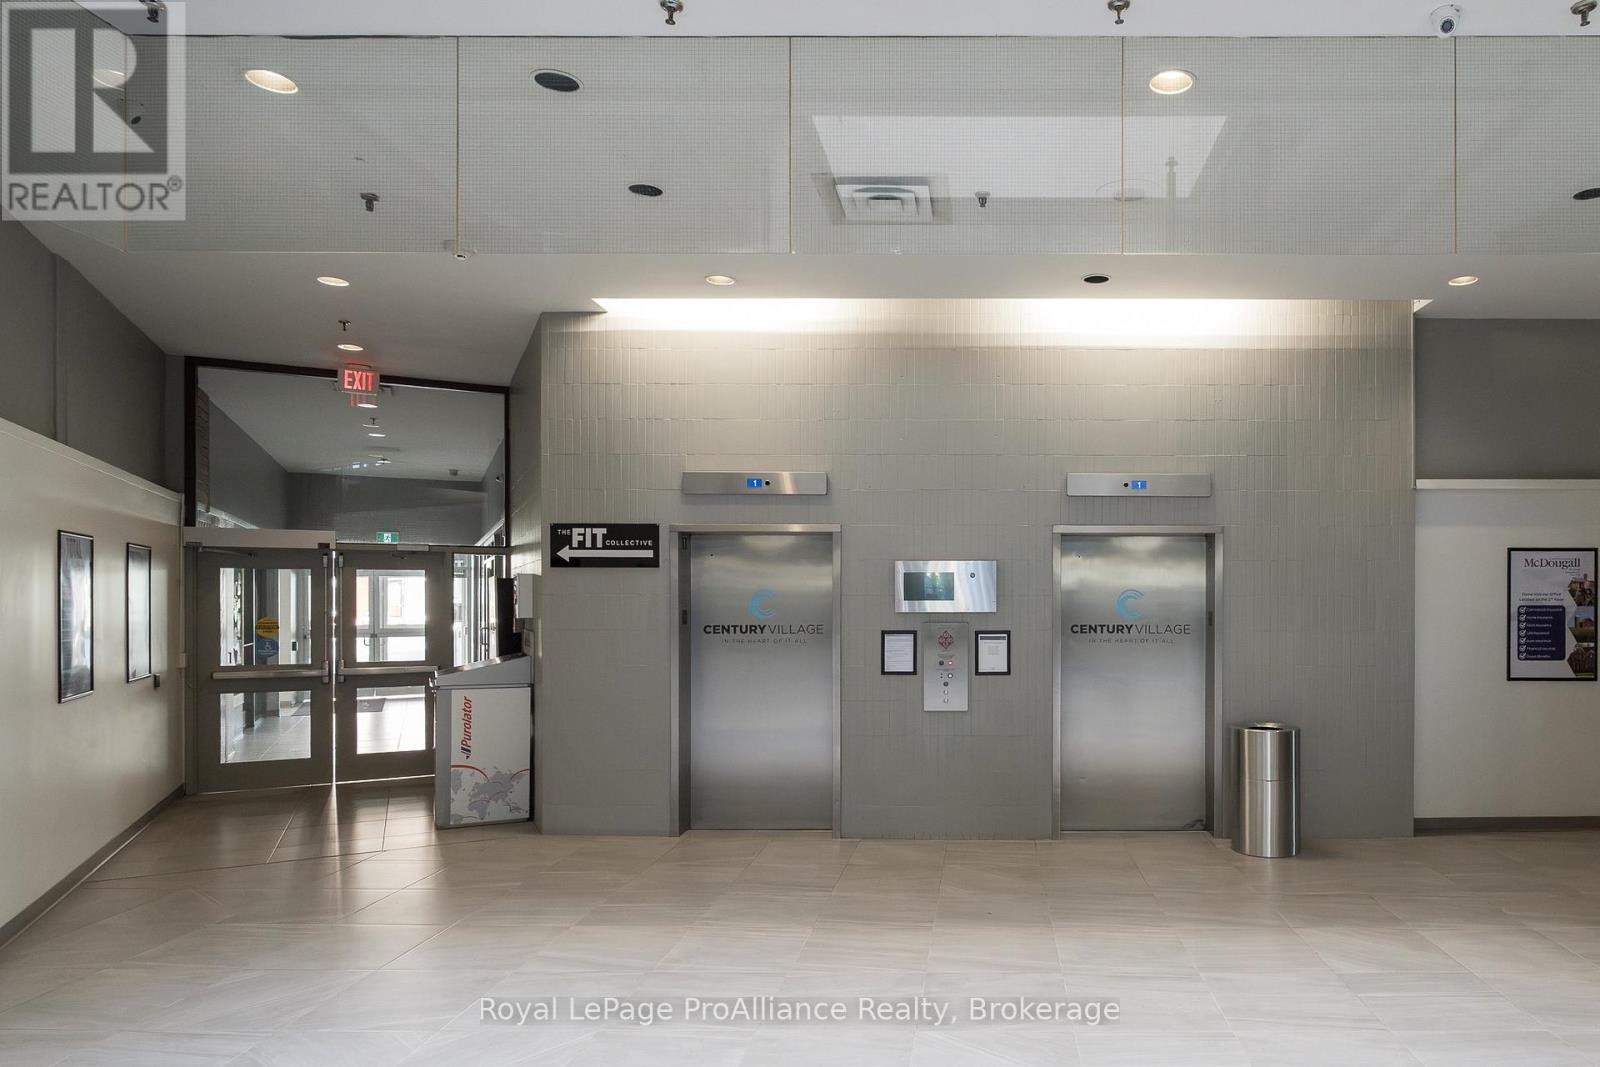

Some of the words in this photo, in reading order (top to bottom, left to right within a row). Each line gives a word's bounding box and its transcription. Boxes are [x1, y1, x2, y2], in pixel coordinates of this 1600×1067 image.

[344, 369, 374, 391] EXIT
[753, 479, 757, 487] 1
[1137, 481, 1141, 489] 1
[572, 527, 607, 548] FIT
[1524, 558, 1581, 569] McDougall
[703, 624, 766, 634] CENTURY
[768, 624, 824, 634] VILLAGE
[1070, 624, 1133, 634] CENTURY
[1135, 624, 1192, 634] VILLAGE
[461, 696, 473, 749] Purolator
